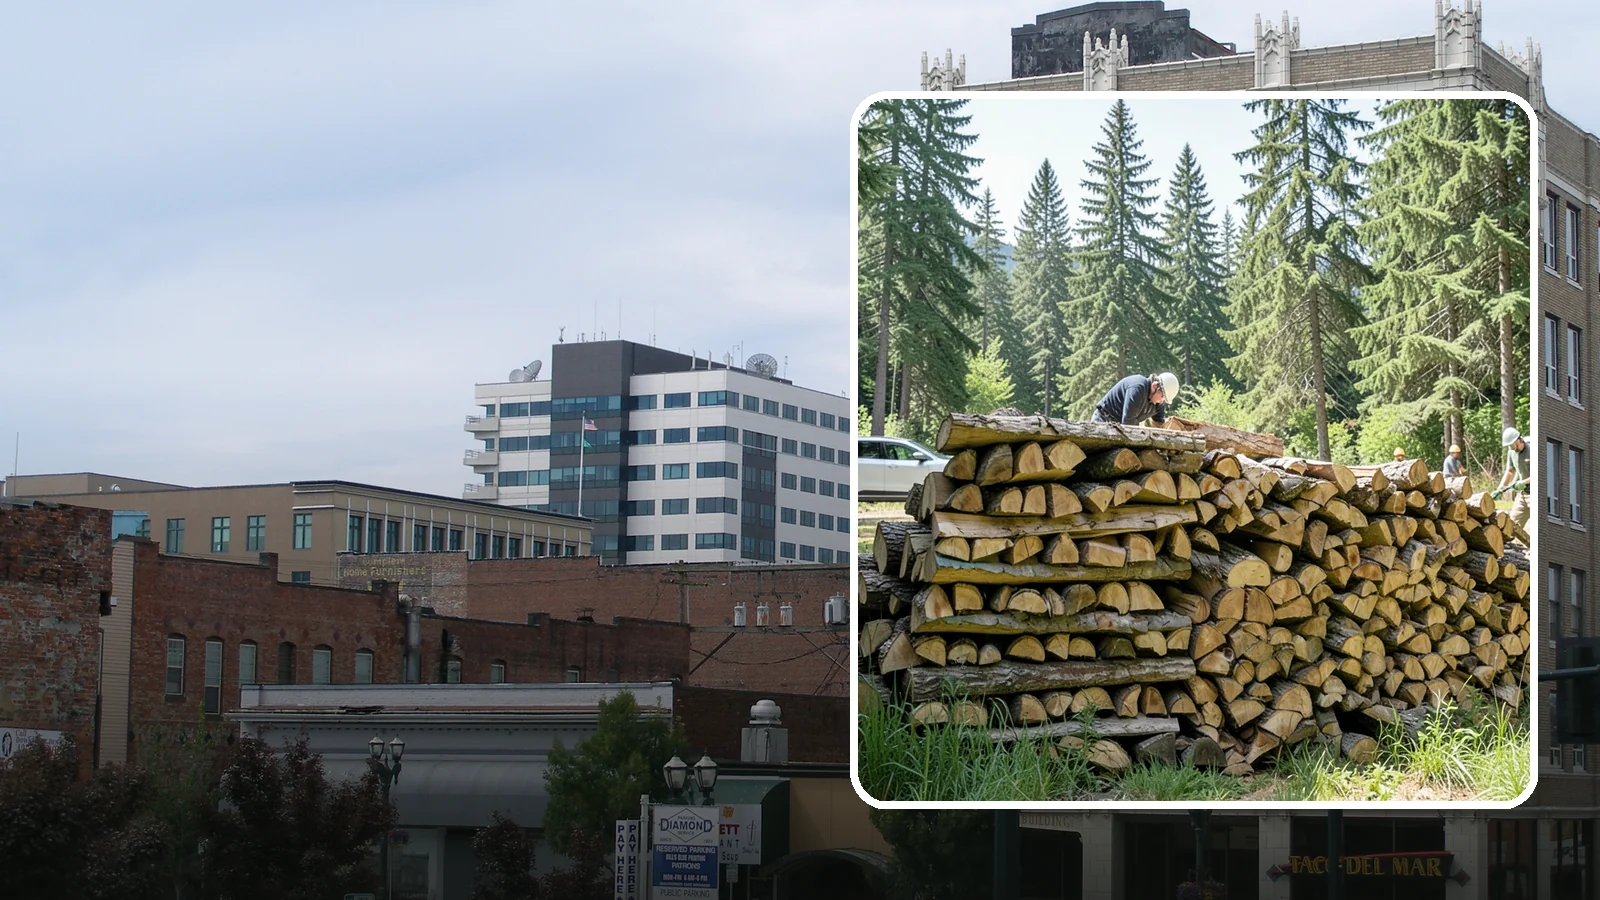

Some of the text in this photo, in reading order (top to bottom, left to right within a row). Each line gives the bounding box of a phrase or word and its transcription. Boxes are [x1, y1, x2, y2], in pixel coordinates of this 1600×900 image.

[343, 568, 368, 577] Home
[660, 818, 713, 832] DIAMOND
[1022, 815, 1069, 828] BUILDING
[689, 846, 716, 854] PARKING
[616, 825, 625, 893] PAY HERE
[627, 824, 637, 893] PAY HERE
[721, 851, 739, 862] Soup
[671, 862, 701, 870] PATRONS
[1346, 856, 1384, 875] DEL
[1393, 857, 1442, 877] MAR
[660, 888, 710, 898] PUBLIC PARKING
